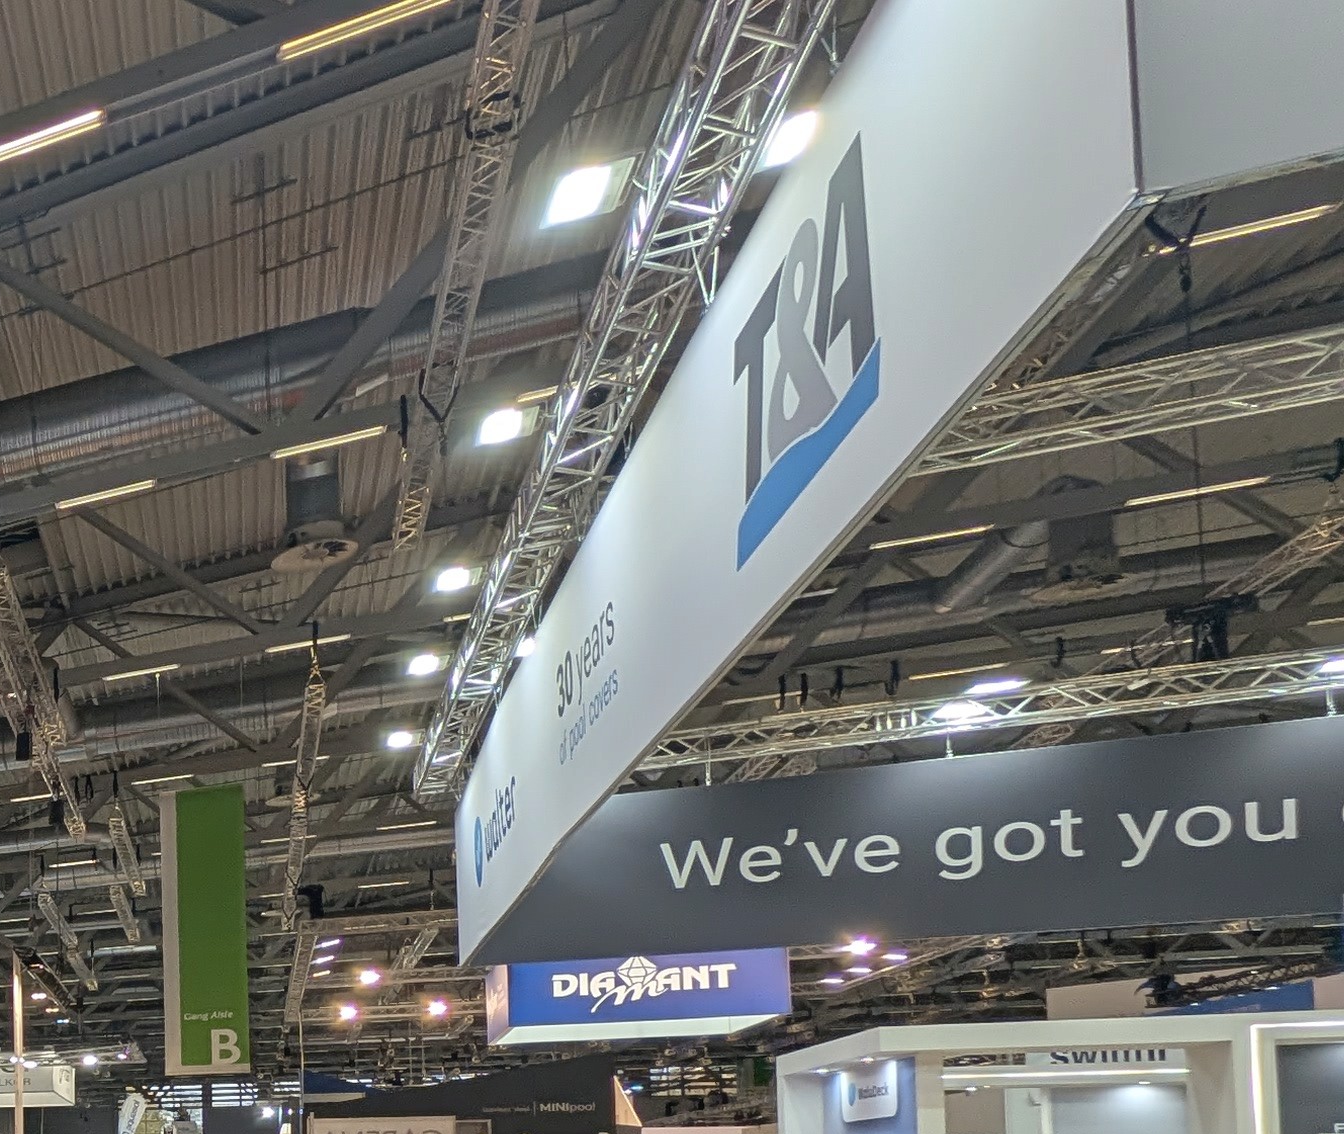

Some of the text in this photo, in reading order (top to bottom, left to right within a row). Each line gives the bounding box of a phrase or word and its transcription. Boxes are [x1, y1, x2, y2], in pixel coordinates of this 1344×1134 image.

[733, 131, 877, 505] T&A
[556, 601, 616, 718] 30 years
[569, 705, 587, 761] pool
[588, 668, 619, 728] covers
[484, 775, 517, 863] walter
[659, 797, 1298, 891] We've got you
[183, 1010, 233, 1021] Gang Aisle
[211, 1028, 241, 1064] B
